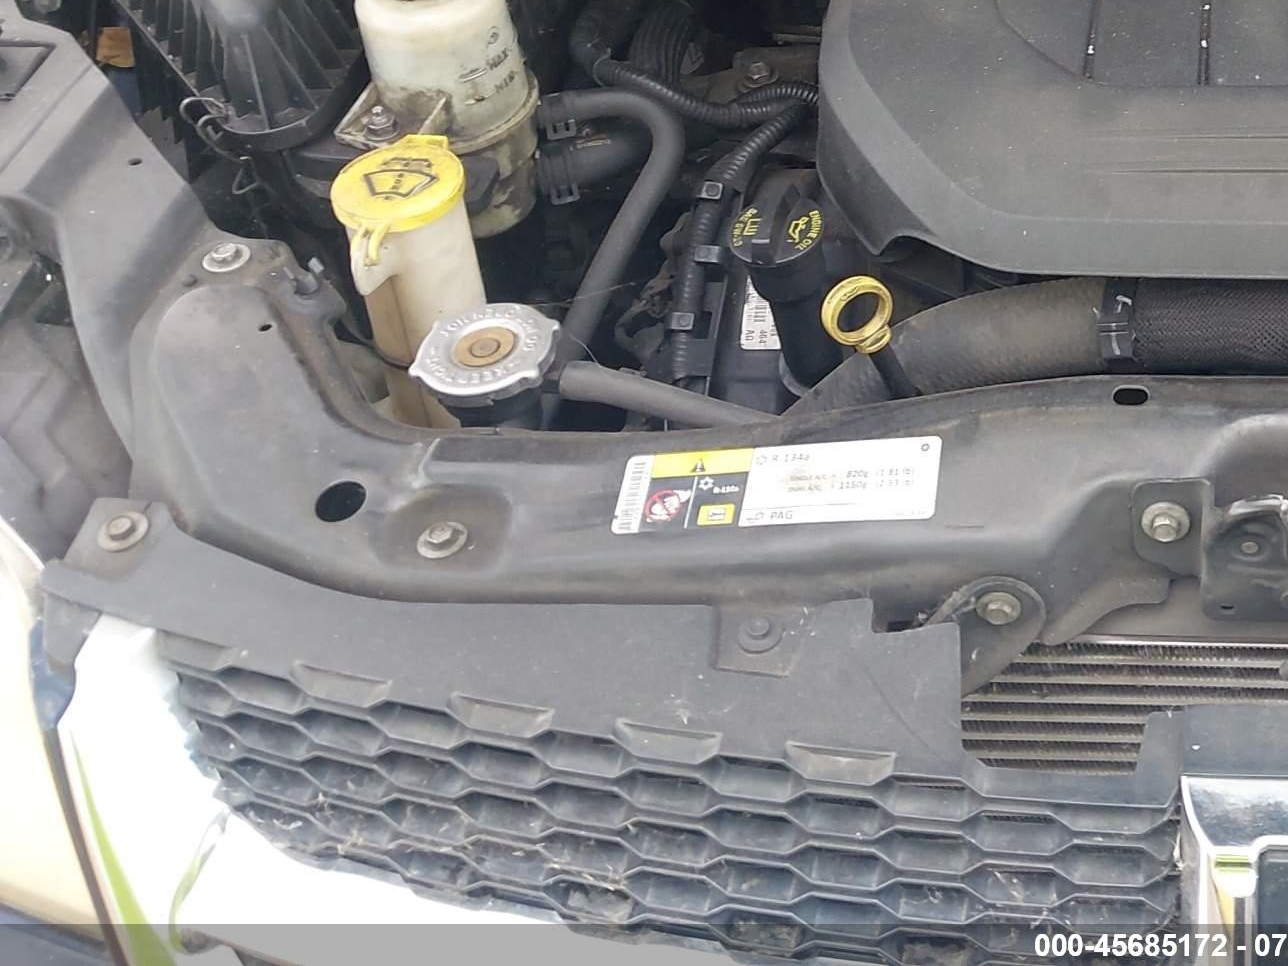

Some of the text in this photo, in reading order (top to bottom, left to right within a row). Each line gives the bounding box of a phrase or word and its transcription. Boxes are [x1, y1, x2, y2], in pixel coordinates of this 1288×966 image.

[794, 209, 822, 251] ENGINE OIL
[770, 511, 793, 520] PAG
